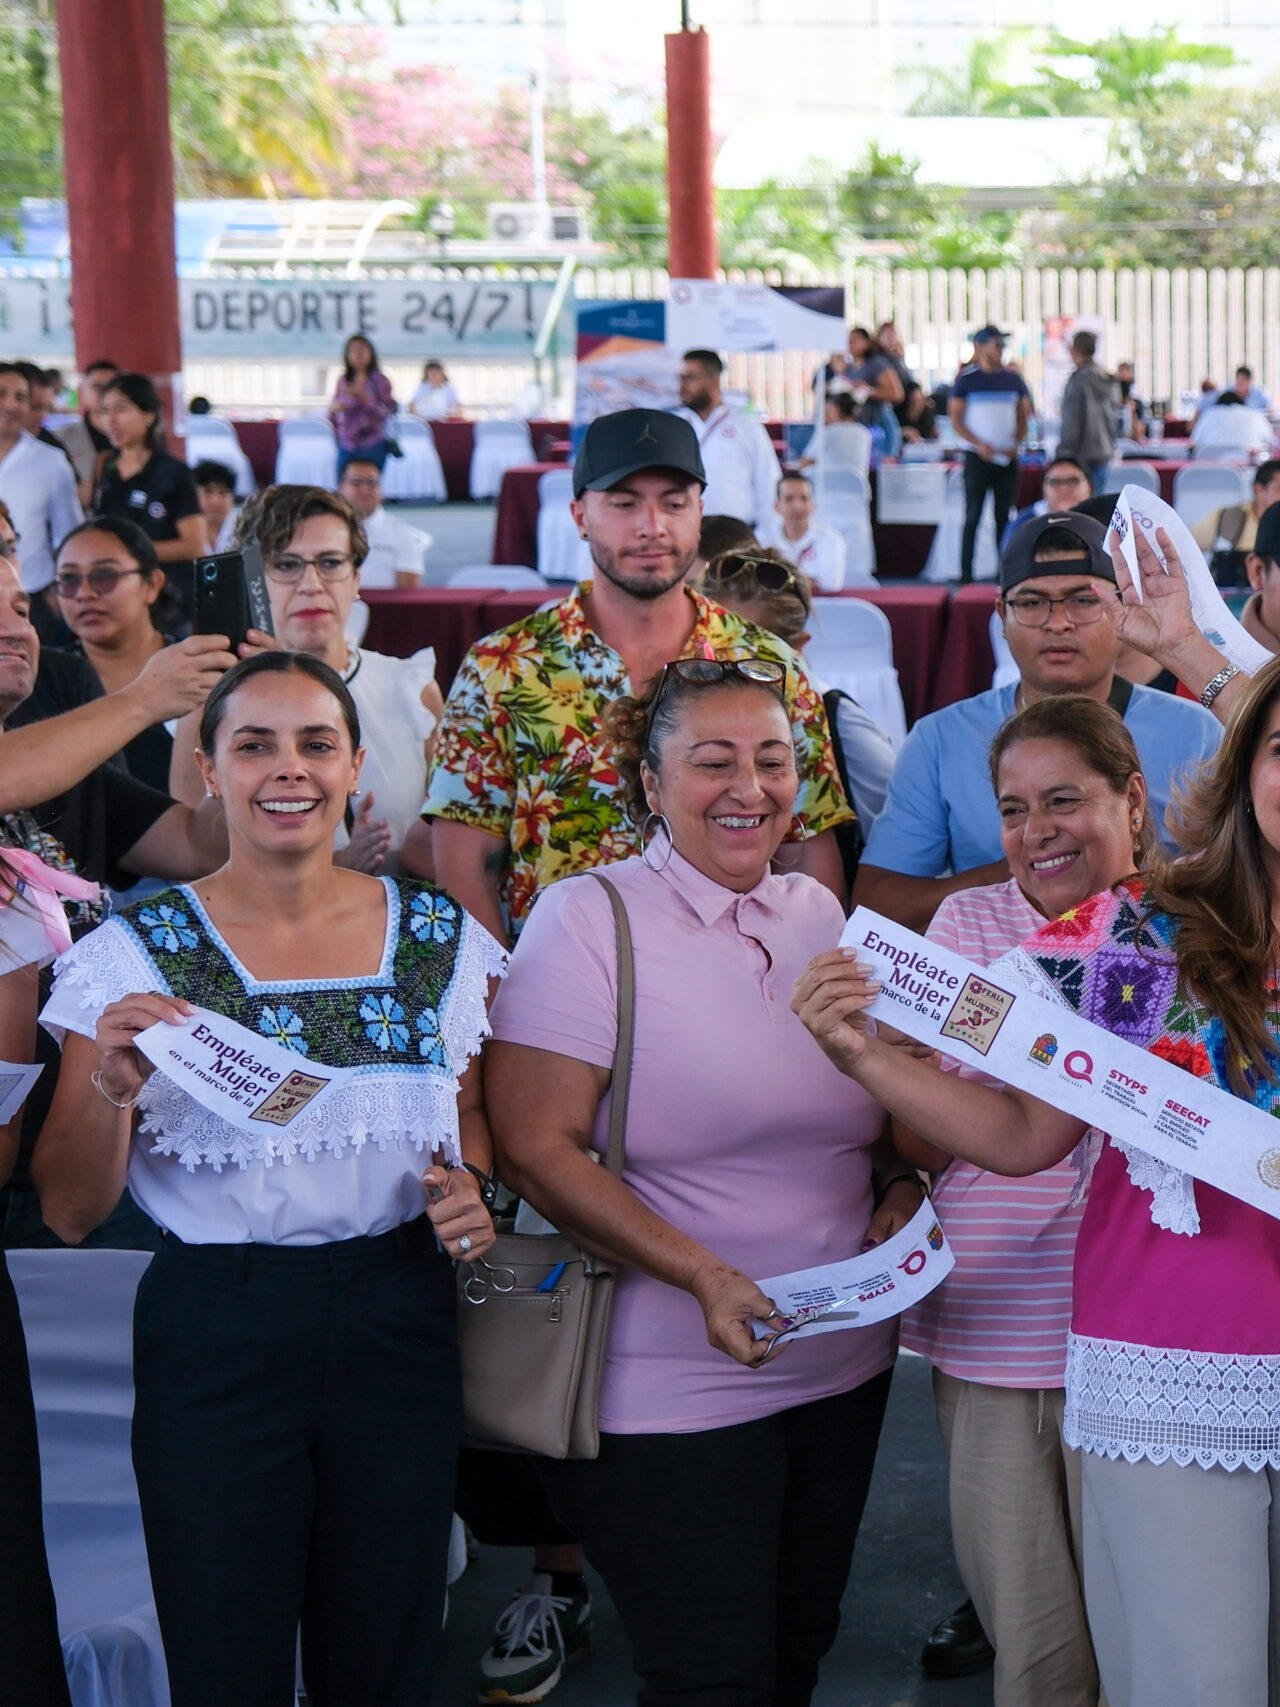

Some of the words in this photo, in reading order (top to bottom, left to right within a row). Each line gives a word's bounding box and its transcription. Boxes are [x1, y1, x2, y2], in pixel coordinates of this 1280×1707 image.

[192, 288, 378, 335] DEPORTE
[862, 930, 959, 989] Empléate
[879, 985, 912, 1007] marco
[914, 1002, 928, 1014] de
[930, 1008, 941, 1021] la
[889, 967, 950, 1007] Mujer
[982, 988, 1004, 1004] FERIA
[964, 996, 1000, 1018] MUJERES
[191, 1024, 281, 1082] Empléate
[168, 1050, 182, 1062] en
[184, 1060, 192, 1070] el
[194, 1068, 228, 1093] marco
[230, 1089, 244, 1102] de
[243, 1097, 255, 1108] la
[209, 1060, 268, 1098] Mujer
[282, 1088, 312, 1098] MUJERES
[1109, 1069, 1148, 1095] STYPS
[1165, 1099, 1212, 1128] SEECAT
[858, 1282, 895, 1302] STYPS
